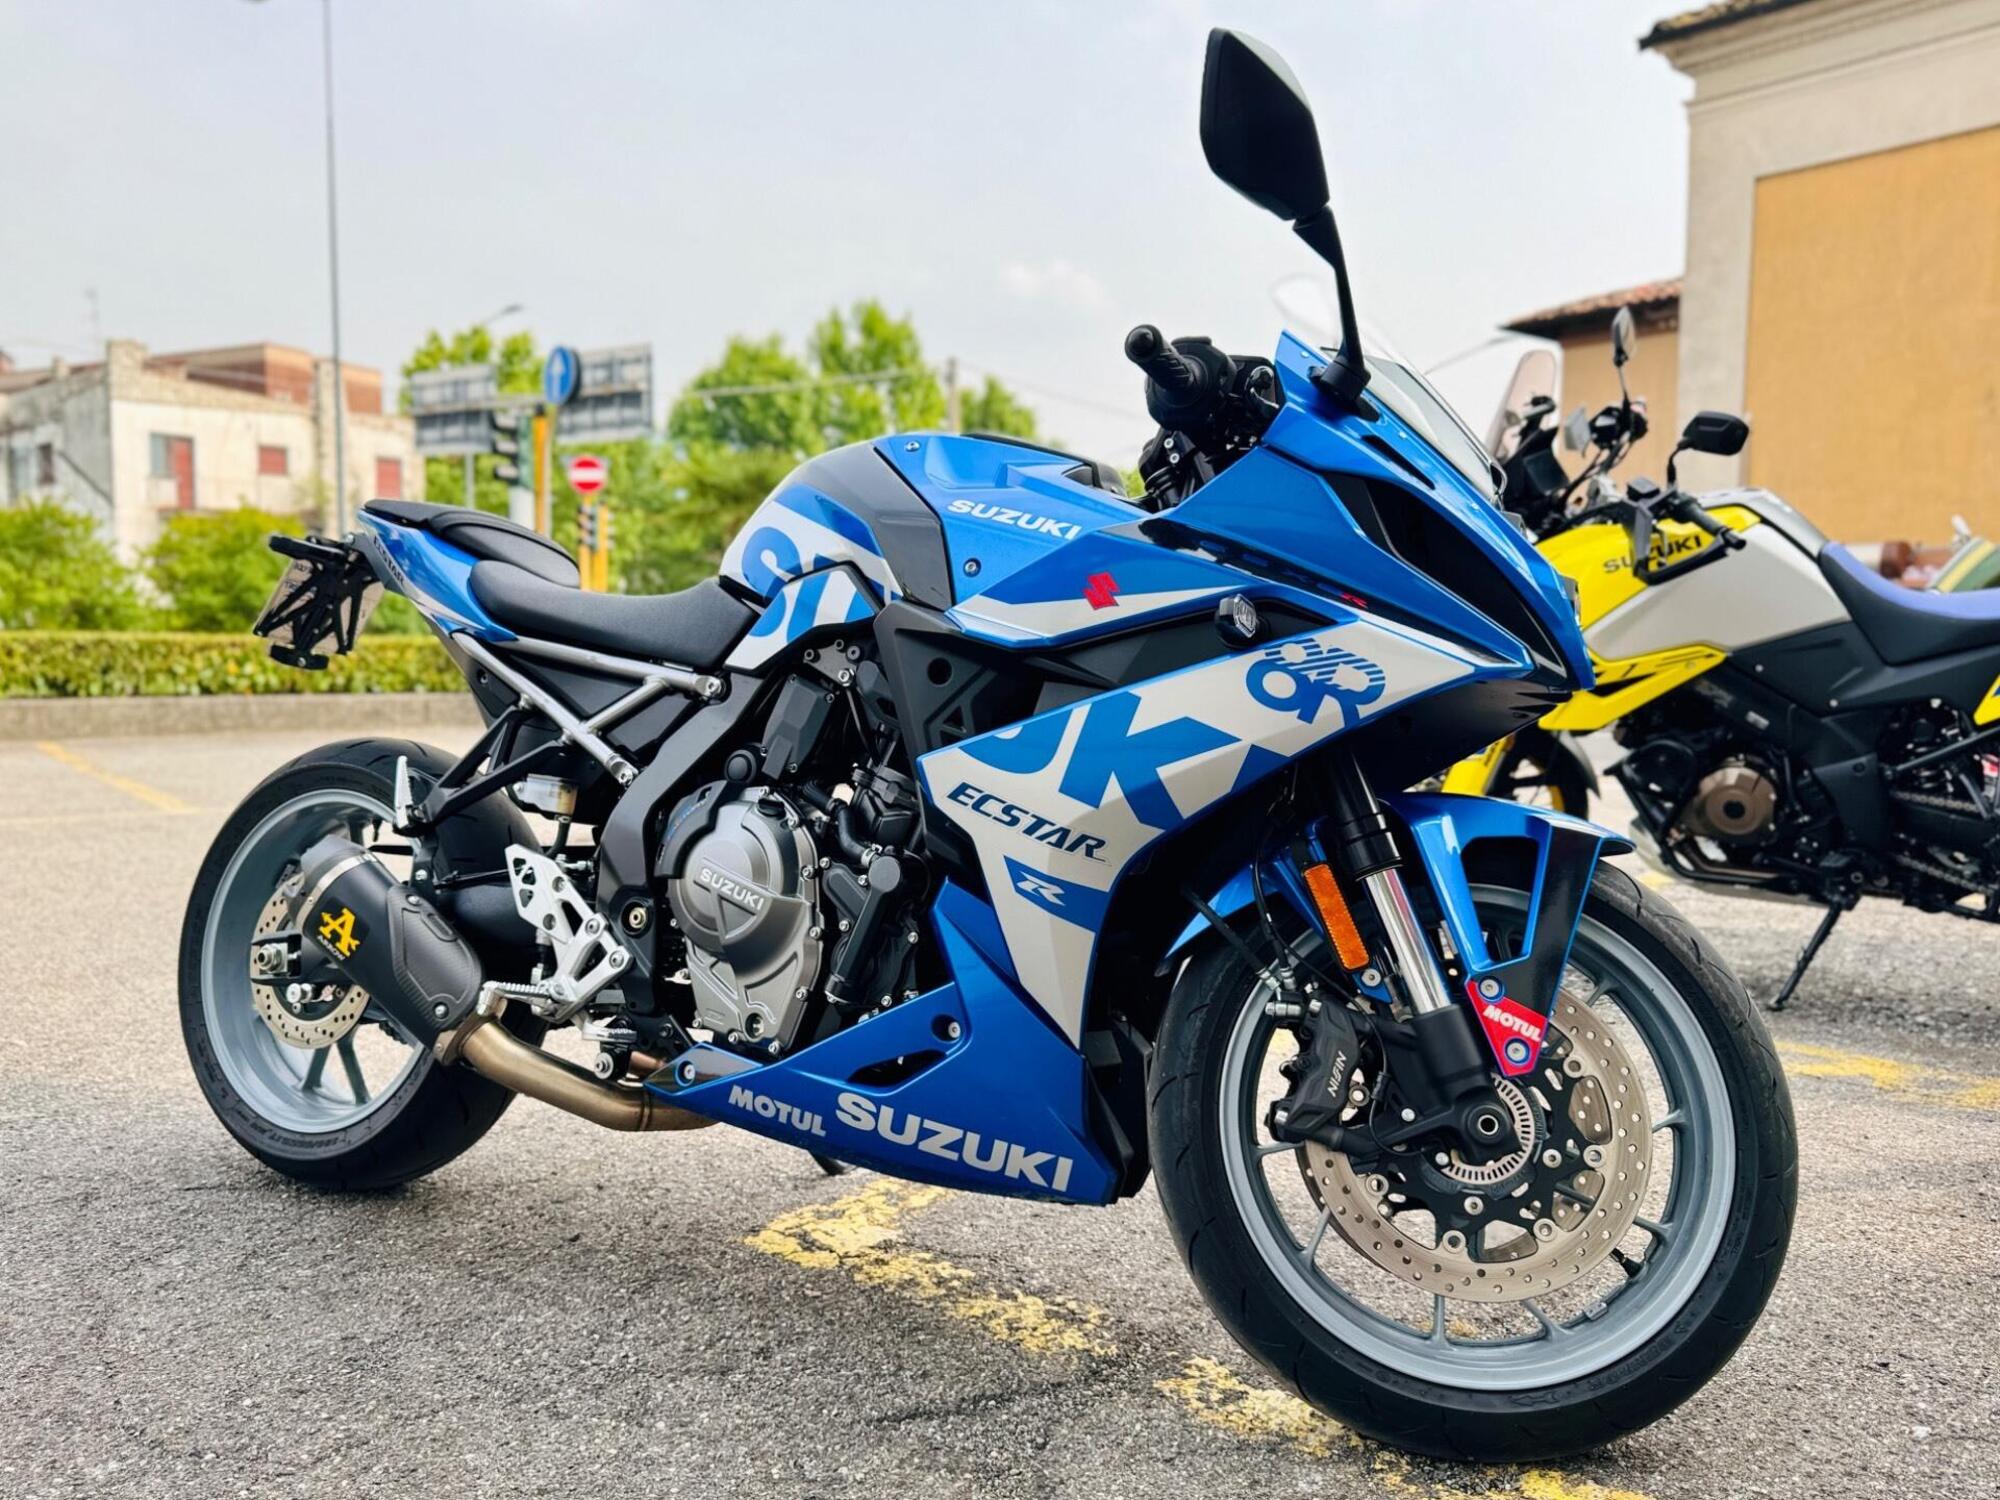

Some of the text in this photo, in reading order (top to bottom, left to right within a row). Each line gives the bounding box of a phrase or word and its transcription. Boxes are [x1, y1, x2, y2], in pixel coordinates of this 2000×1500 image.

[947, 499, 1083, 540] SUZUKI
[1602, 535, 1703, 574] SUUKI
[946, 781, 1113, 867] ECSTAR
[699, 867, 765, 912] SUZUKI
[1482, 1004, 1543, 1043] MOTUL
[1327, 1051, 1348, 1098] NISSIN
[728, 1084, 827, 1138] MOTUL
[835, 1092, 1074, 1193] SUZUKI
